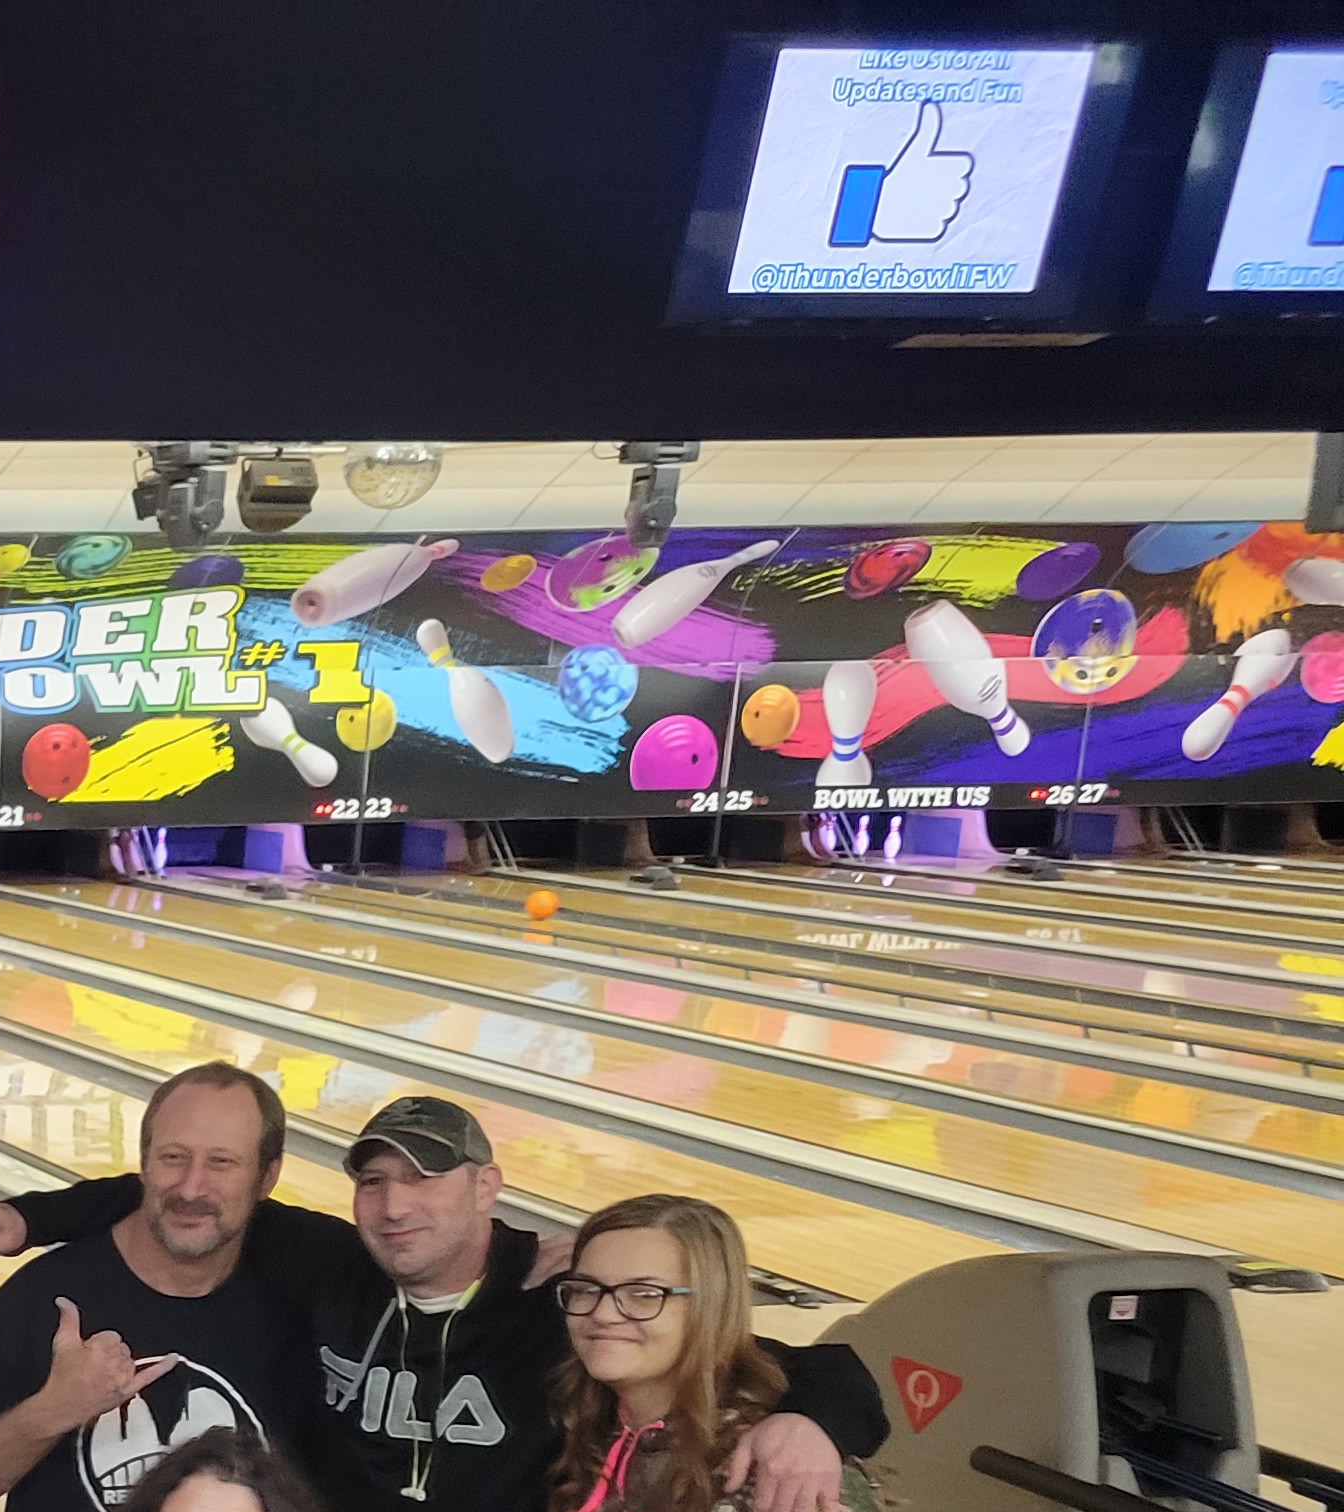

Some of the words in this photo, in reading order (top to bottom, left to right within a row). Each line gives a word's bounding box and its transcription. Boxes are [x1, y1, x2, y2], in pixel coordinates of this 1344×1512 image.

[833, 77, 928, 107] Updates
[927, 79, 975, 103] and
[980, 80, 1023, 103] Fun
[689, 790, 720, 814] 24
[723, 790, 755, 813] 25
[813, 787, 884, 811] BOWL
[886, 786, 953, 810] WITH
[955, 785, 991, 807] US
[1044, 784, 1076, 807] 26
[1076, 782, 1110, 806] 27
[329, 799, 361, 821] 22
[363, 797, 395, 819] 23
[907, 1369, 940, 1421] Q
